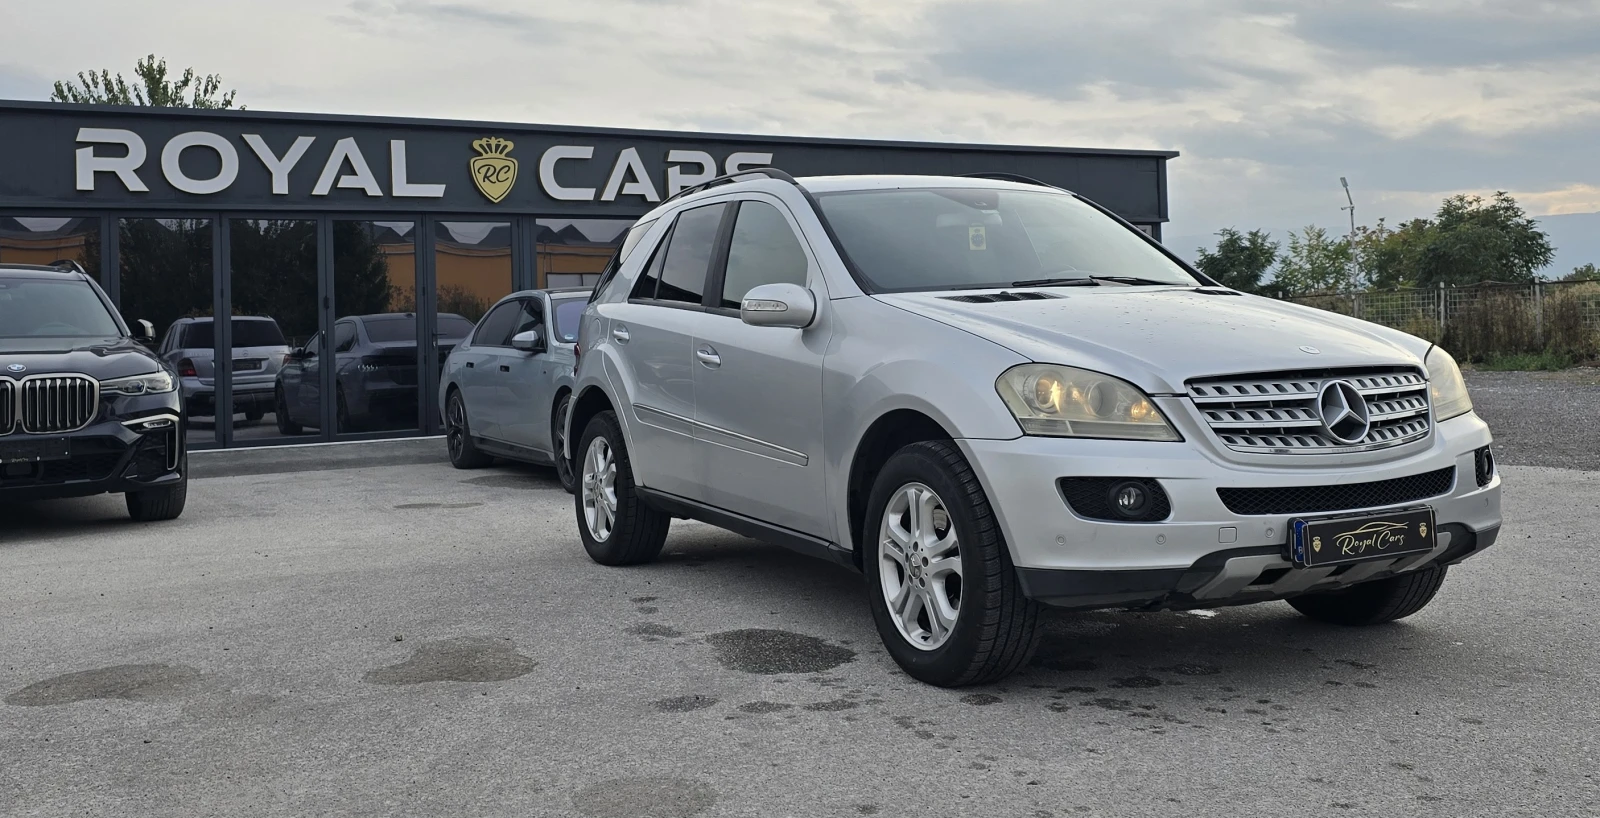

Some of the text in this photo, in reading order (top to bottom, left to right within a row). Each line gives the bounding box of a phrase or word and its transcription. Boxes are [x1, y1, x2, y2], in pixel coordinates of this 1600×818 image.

[75, 127, 446, 198] ROYAL
[477, 163, 511, 184] RC
[1336, 530, 1405, 555] Royal Cars
